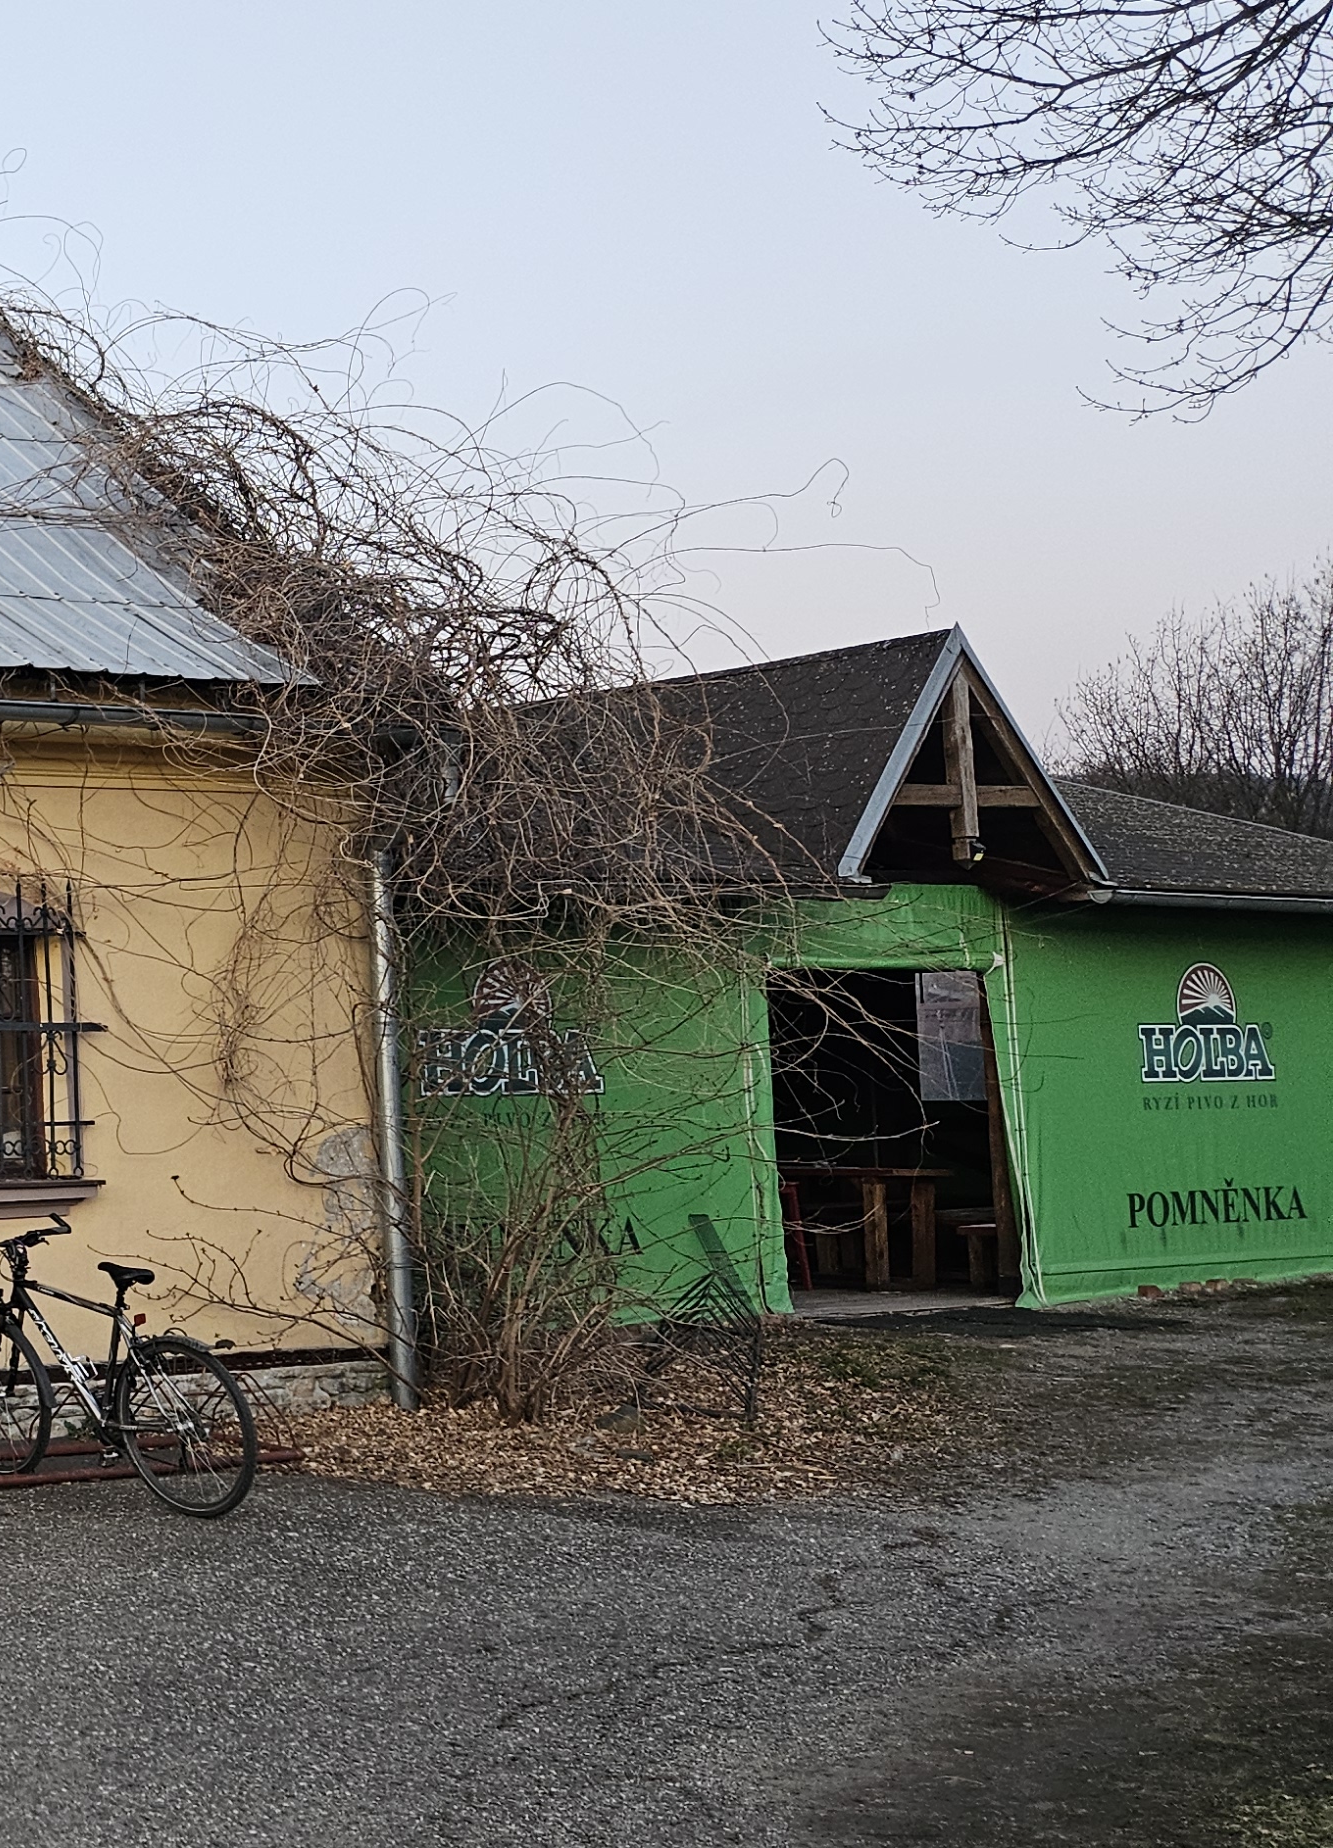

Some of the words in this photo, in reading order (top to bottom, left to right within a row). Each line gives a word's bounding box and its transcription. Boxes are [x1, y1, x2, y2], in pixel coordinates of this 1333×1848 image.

[1138, 1023, 1276, 1083] HOLBA
[1143, 1093, 1180, 1111] RYZÍ
[1187, 1096, 1223, 1110] PIVO
[1231, 1095, 1240, 1109] Z
[1247, 1093, 1279, 1109] HOR
[1127, 1177, 1308, 1228] POMNĚNKA
